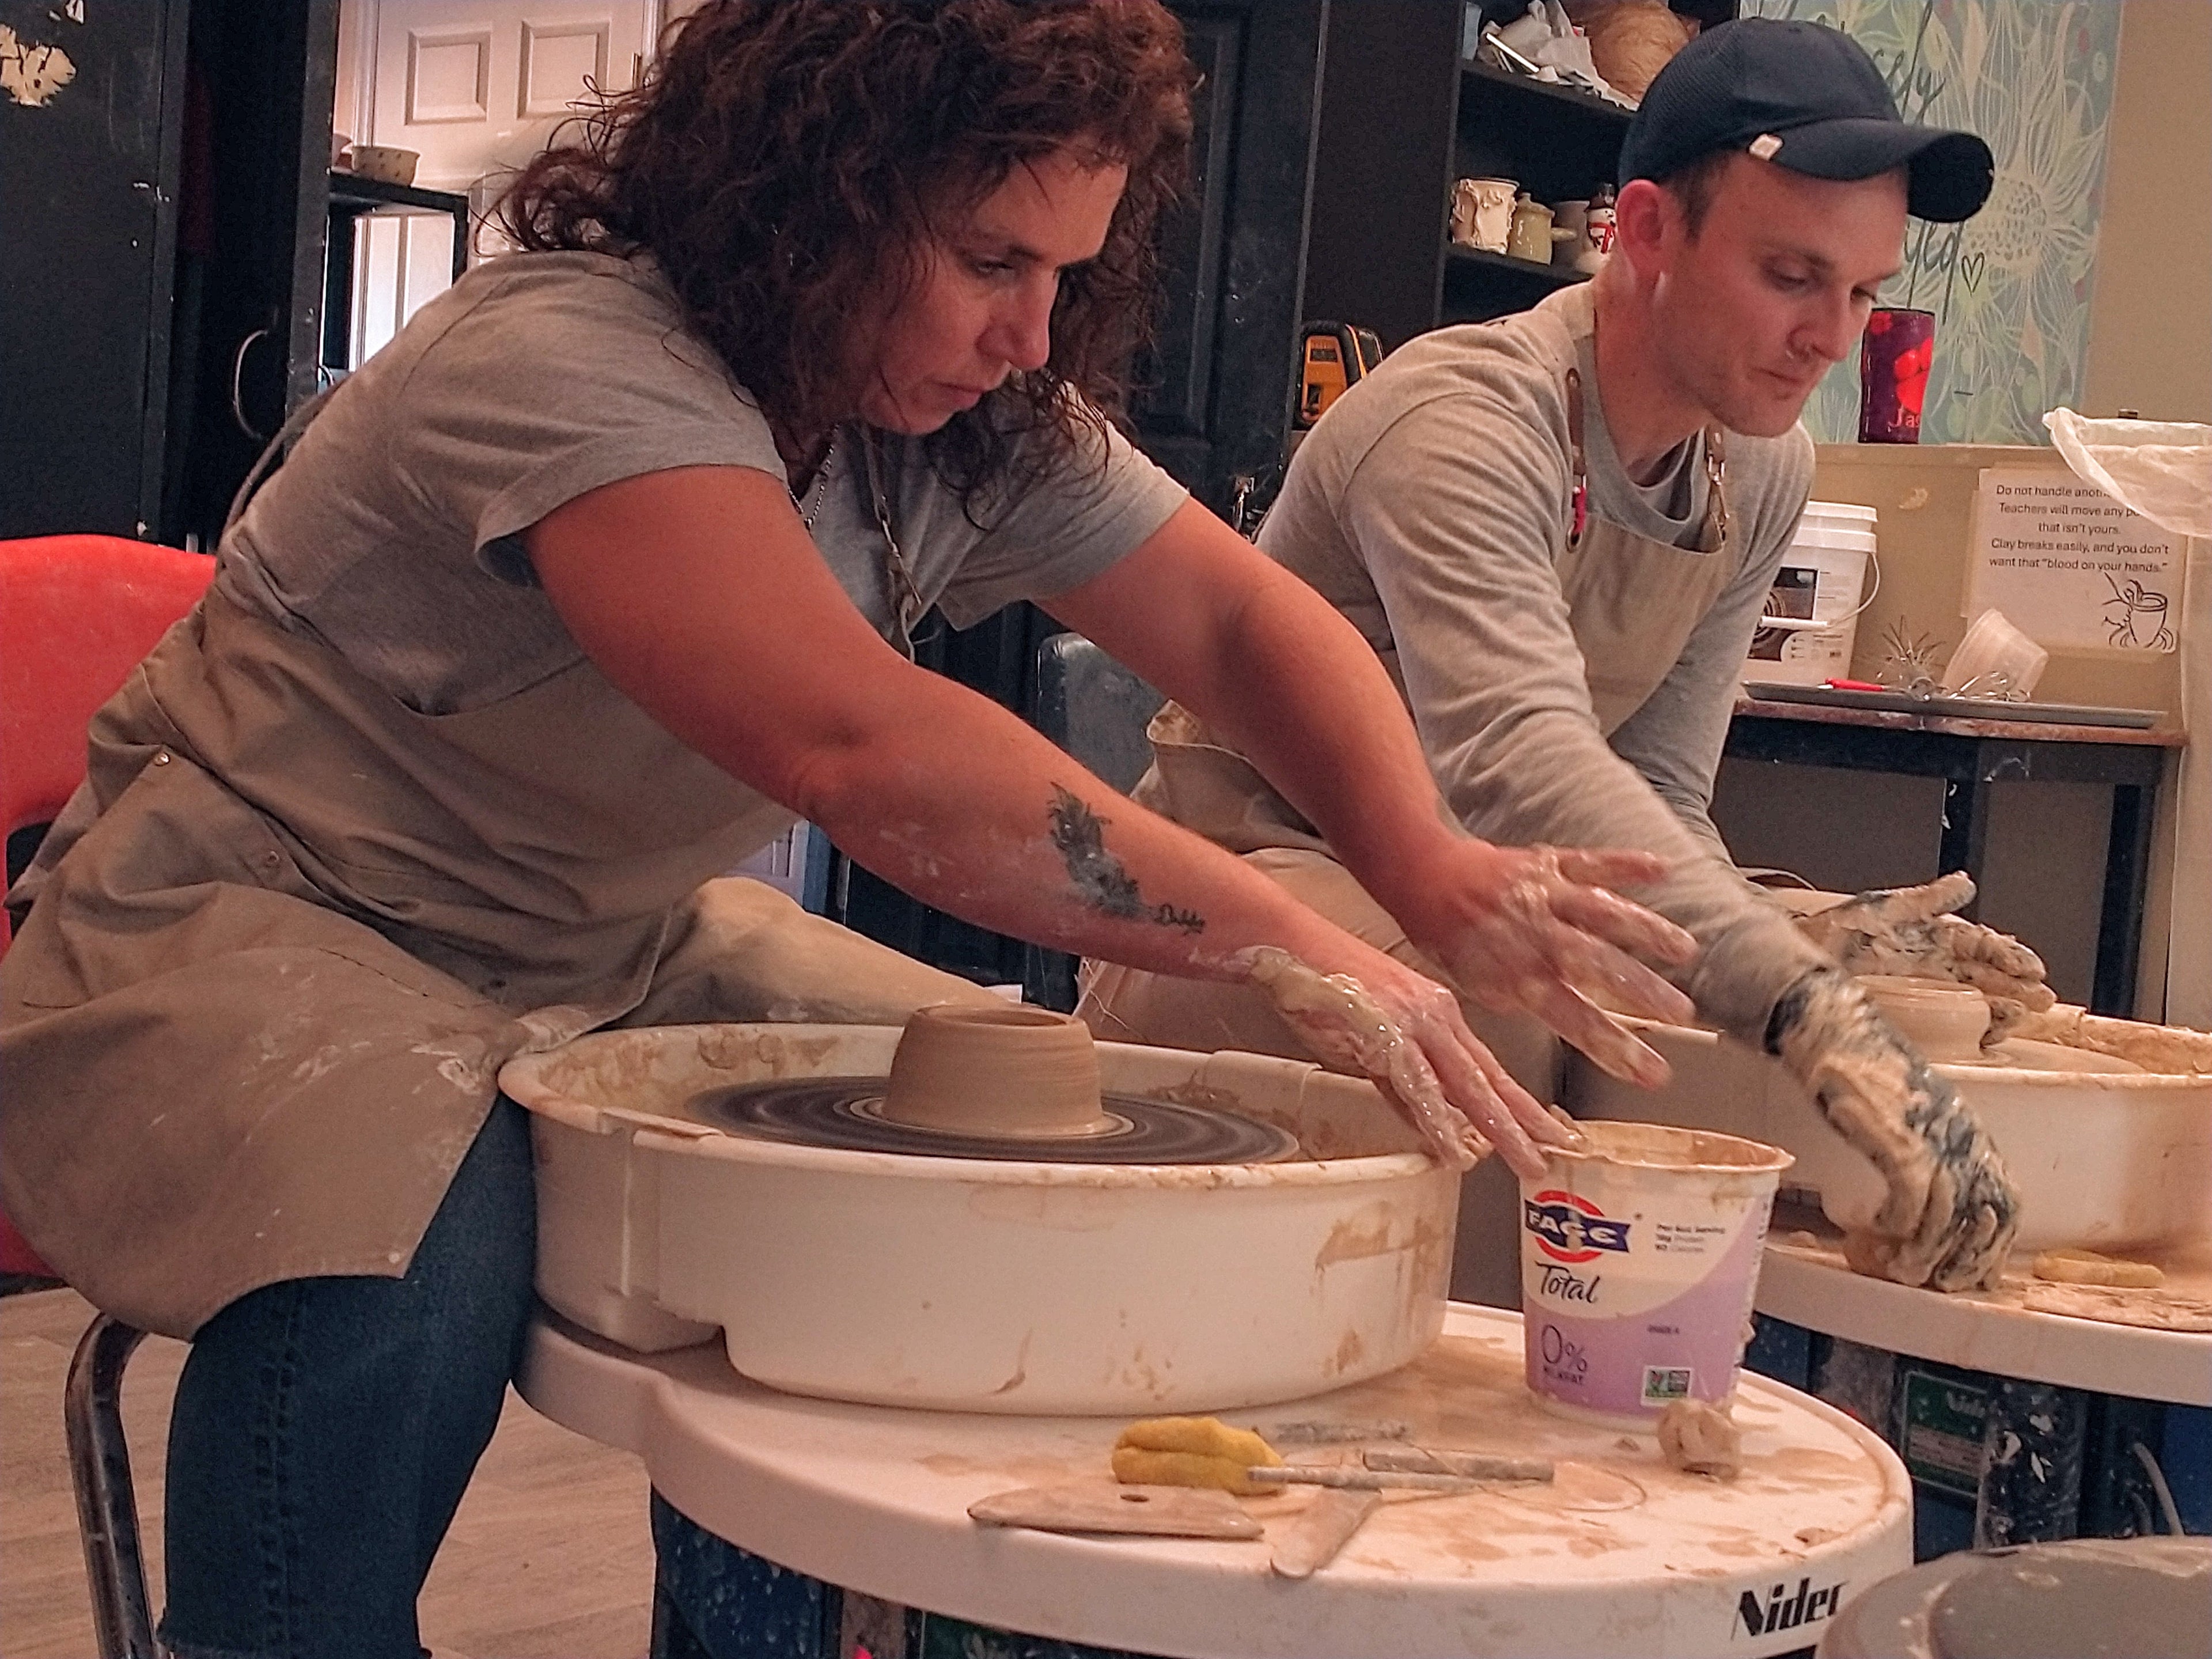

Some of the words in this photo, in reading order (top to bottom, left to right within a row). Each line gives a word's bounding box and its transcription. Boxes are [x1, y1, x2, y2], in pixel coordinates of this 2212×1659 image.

[1996, 484, 2012, 495] Do
[2014, 486, 2032, 496] not
[2035, 487, 2072, 497] handle
[1999, 502, 2048, 514] Teachers
[2050, 505, 2068, 515] will
[2070, 507, 2101, 516] move
[2104, 507, 2123, 518] any
[2039, 522, 2061, 533] that
[2062, 522, 2085, 533] isn't
[2088, 525, 2121, 536] yours.
[1991, 537, 2016, 550] Clay
[2017, 539, 2054, 550] breaks
[2056, 540, 2090, 554] easily,
[2093, 542, 2114, 552] and
[2116, 545, 2137, 555] you
[2139, 543, 2169, 555] don't
[1989, 557, 2016, 567] want
[2018, 558, 2040, 568] that
[2081, 562, 2096, 570] on
[2098, 561, 2122, 571] your
[1528, 1210, 1618, 1244] FAGE
[1534, 1260, 1601, 1304] Total
[1541, 1325, 1588, 1372] 0%
